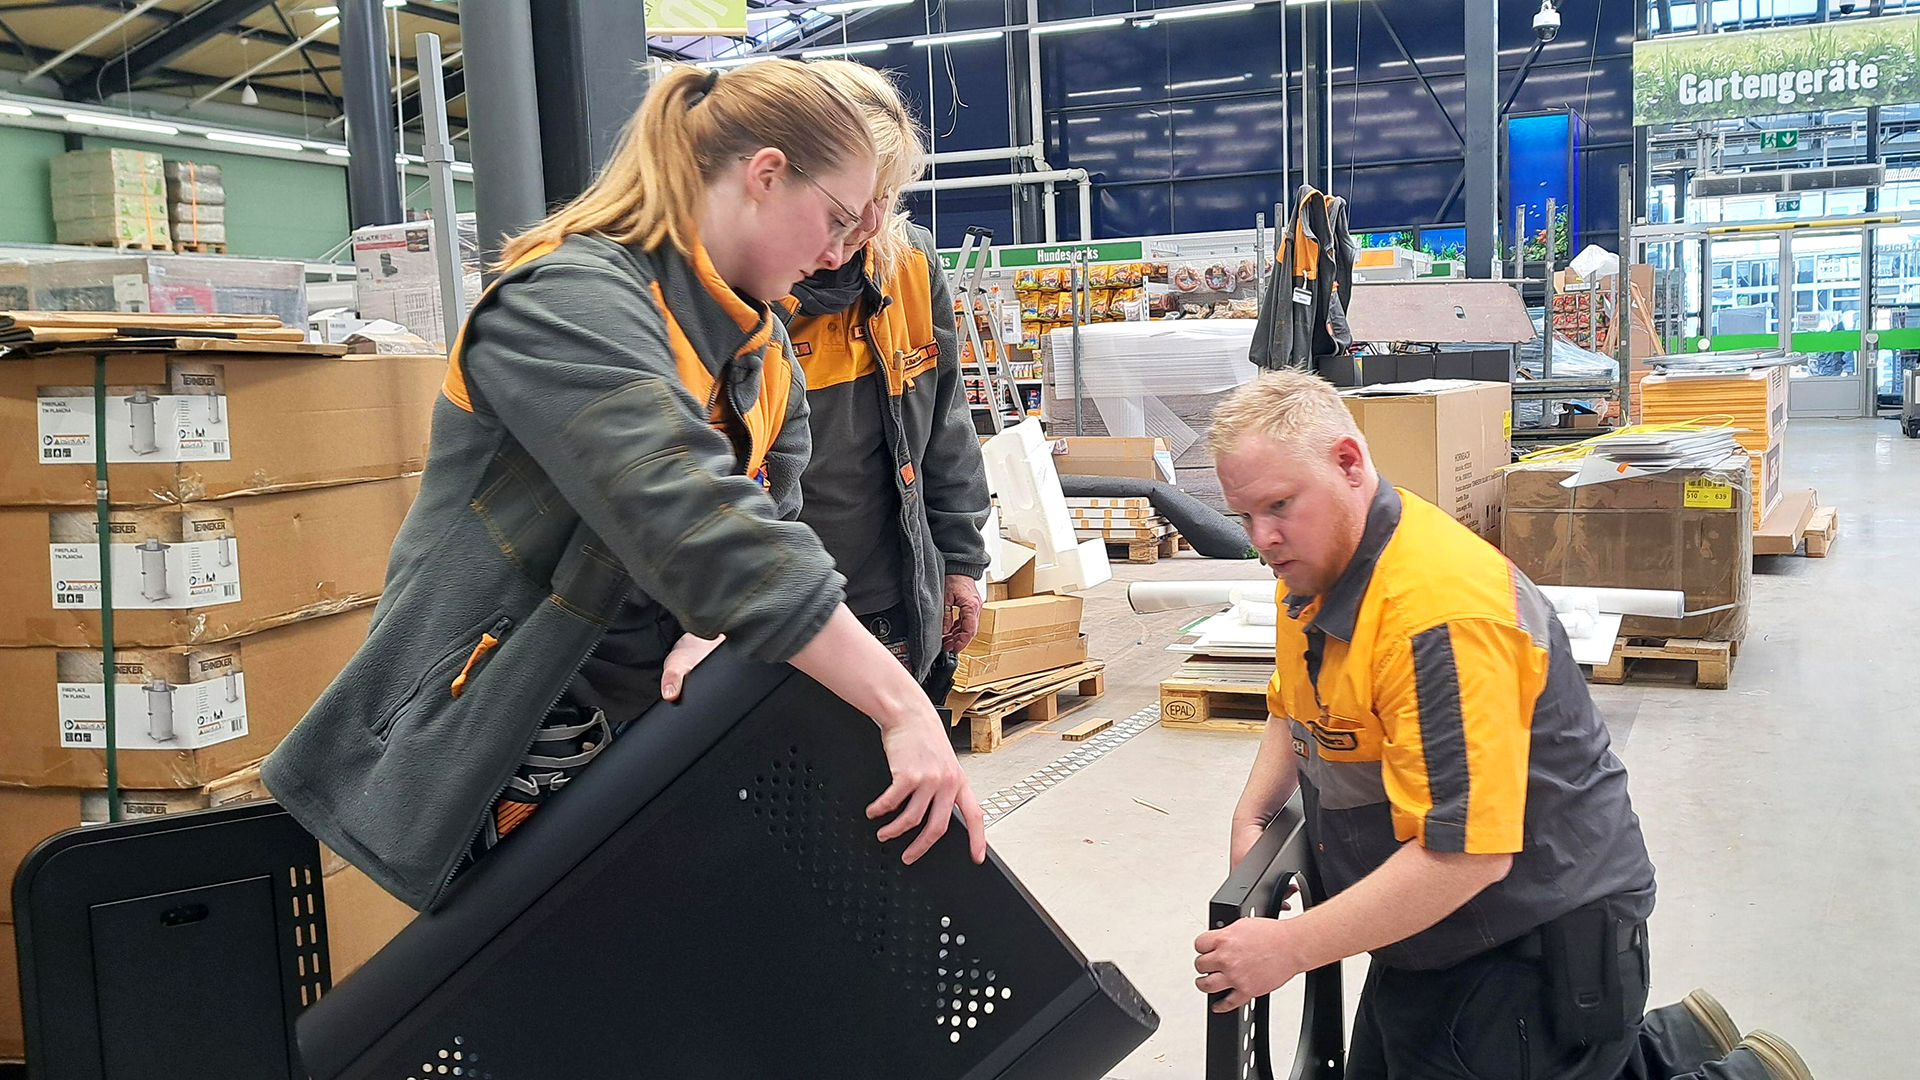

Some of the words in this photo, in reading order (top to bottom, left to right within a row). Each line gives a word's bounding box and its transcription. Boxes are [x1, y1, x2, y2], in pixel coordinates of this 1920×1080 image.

[1679, 60, 1879, 106] Gartengeräte
[939, 254, 951, 268] ks
[1037, 246, 1099, 263] Hundesaks
[181, 373, 217, 386] TENNEKER
[92, 521, 137, 534] TNEKER
[191, 518, 226, 533] TENNEKER
[198, 654, 233, 672] TENNEKER
[1169, 704, 1192, 717] EPAL
[123, 801, 168, 815] TENNEKER
